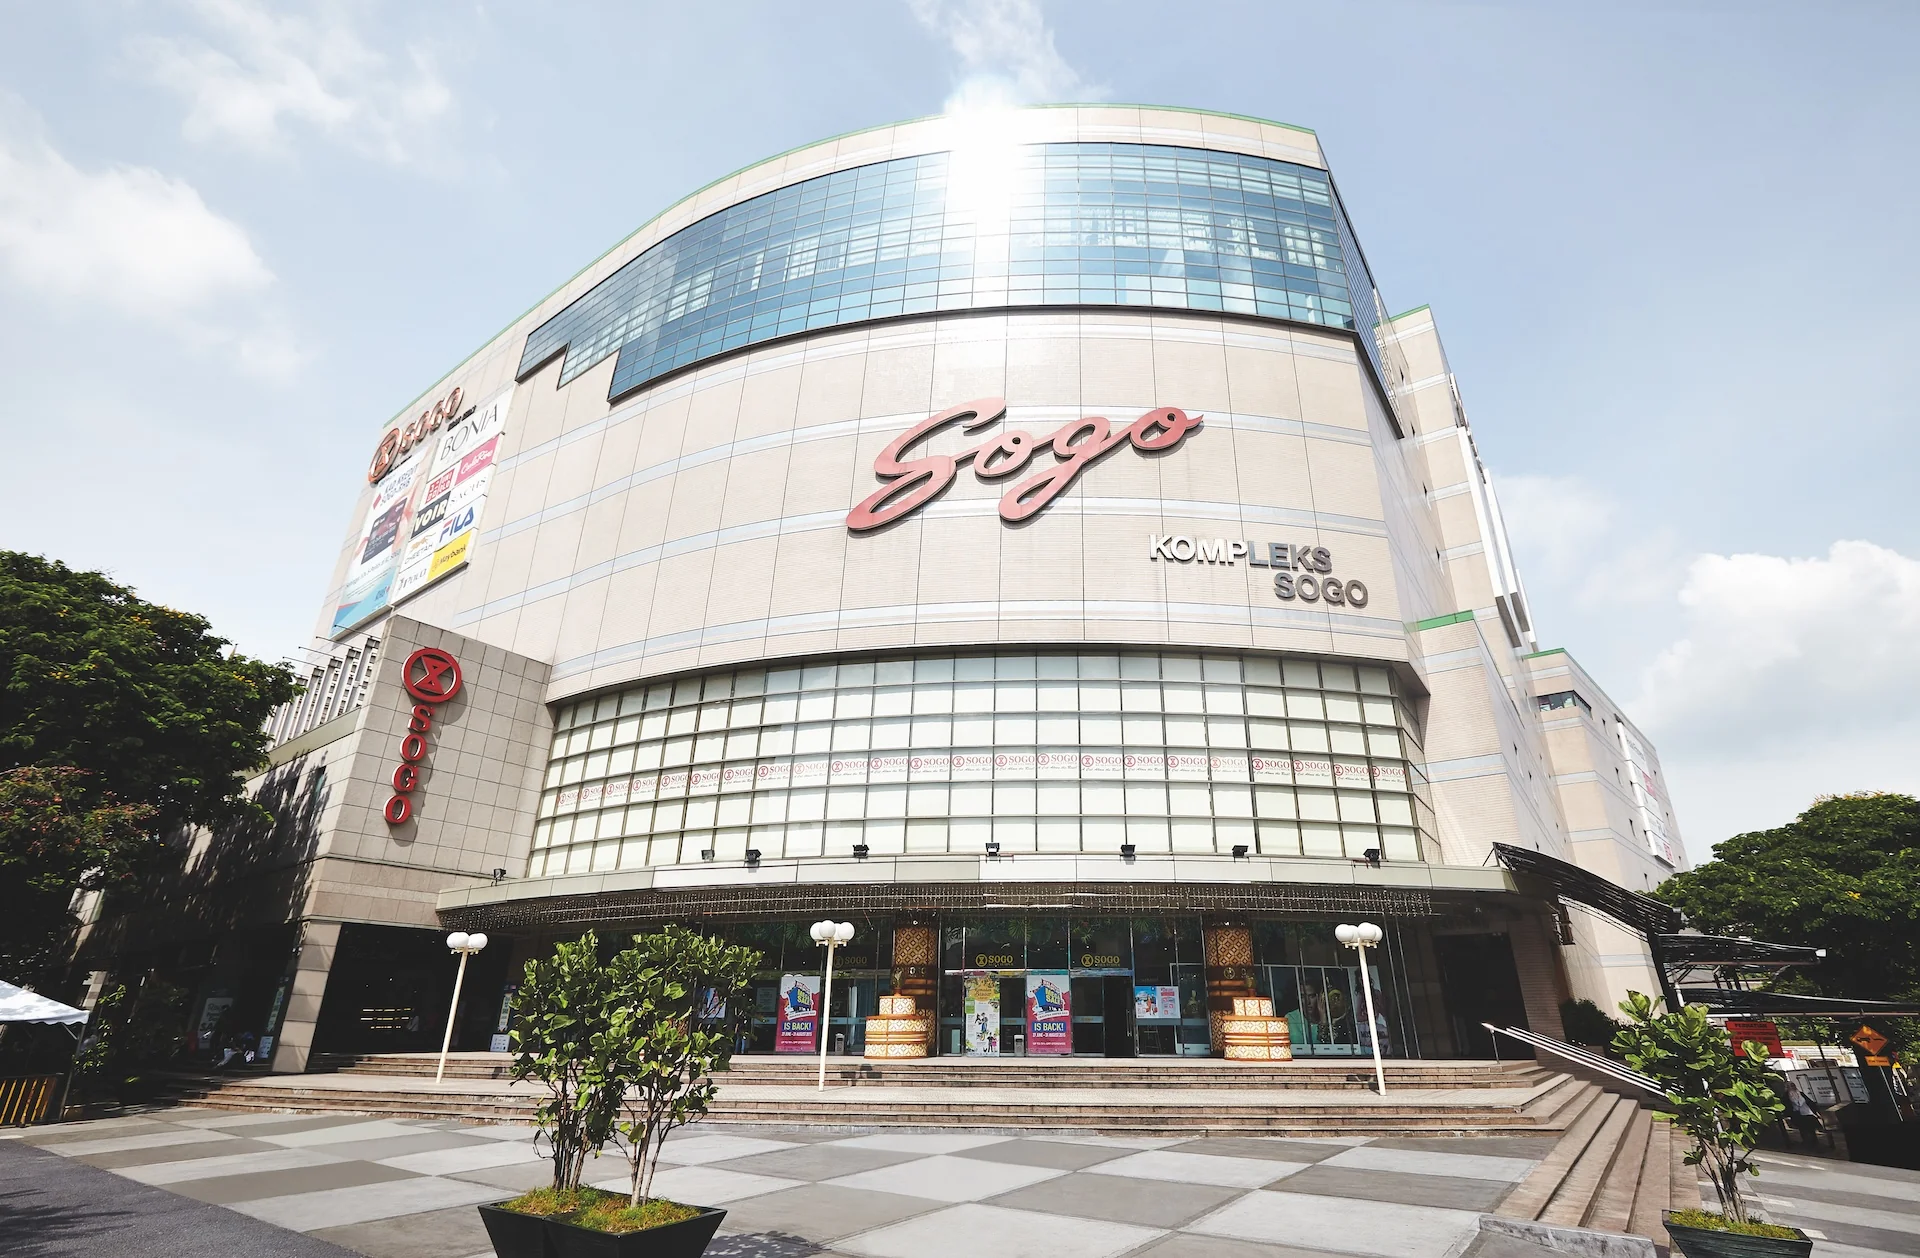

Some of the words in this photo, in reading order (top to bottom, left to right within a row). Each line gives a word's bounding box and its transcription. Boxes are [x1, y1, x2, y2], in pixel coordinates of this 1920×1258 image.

[399, 387, 464, 453] SOGO
[441, 403, 498, 460] BONIA
[846, 397, 1204, 531] Sogo
[414, 499, 448, 532] VOIR
[439, 506, 474, 543] FILA
[440, 544, 467, 564] Maybank
[1149, 534, 1332, 573] KOMPLEKS
[1273, 572, 1369, 607] SOGO
[883, 758, 908, 766] SOGO
[923, 758, 949, 766] SOGO
[966, 756, 992, 765] SOGO
[1008, 755, 1035, 763] SOGO
[1051, 754, 1078, 762] SOGO
[1095, 756, 1121, 764] SOGO
[1137, 756, 1164, 764] SOGO
[1180, 757, 1207, 765] SOGO
[383, 703, 436, 824] SOGO
[805, 762, 828, 771] SOGO
[844, 760, 868, 769] SOGO
[1264, 760, 1290, 769] SOGO
[1305, 761, 1330, 770] SOGO
[1344, 766, 1370, 775] SOGO
[1381, 767, 1406, 776] SOGO
[844, 956, 868, 965] SOGO
[988, 955, 1014, 964] SOGO
[1094, 955, 1120, 964] SOGO
[784, 1022, 791, 1030] IS
[792, 1022, 812, 1030] BACK!
[1034, 1023, 1041, 1031] IS
[1043, 1023, 1064, 1031] BACK!
